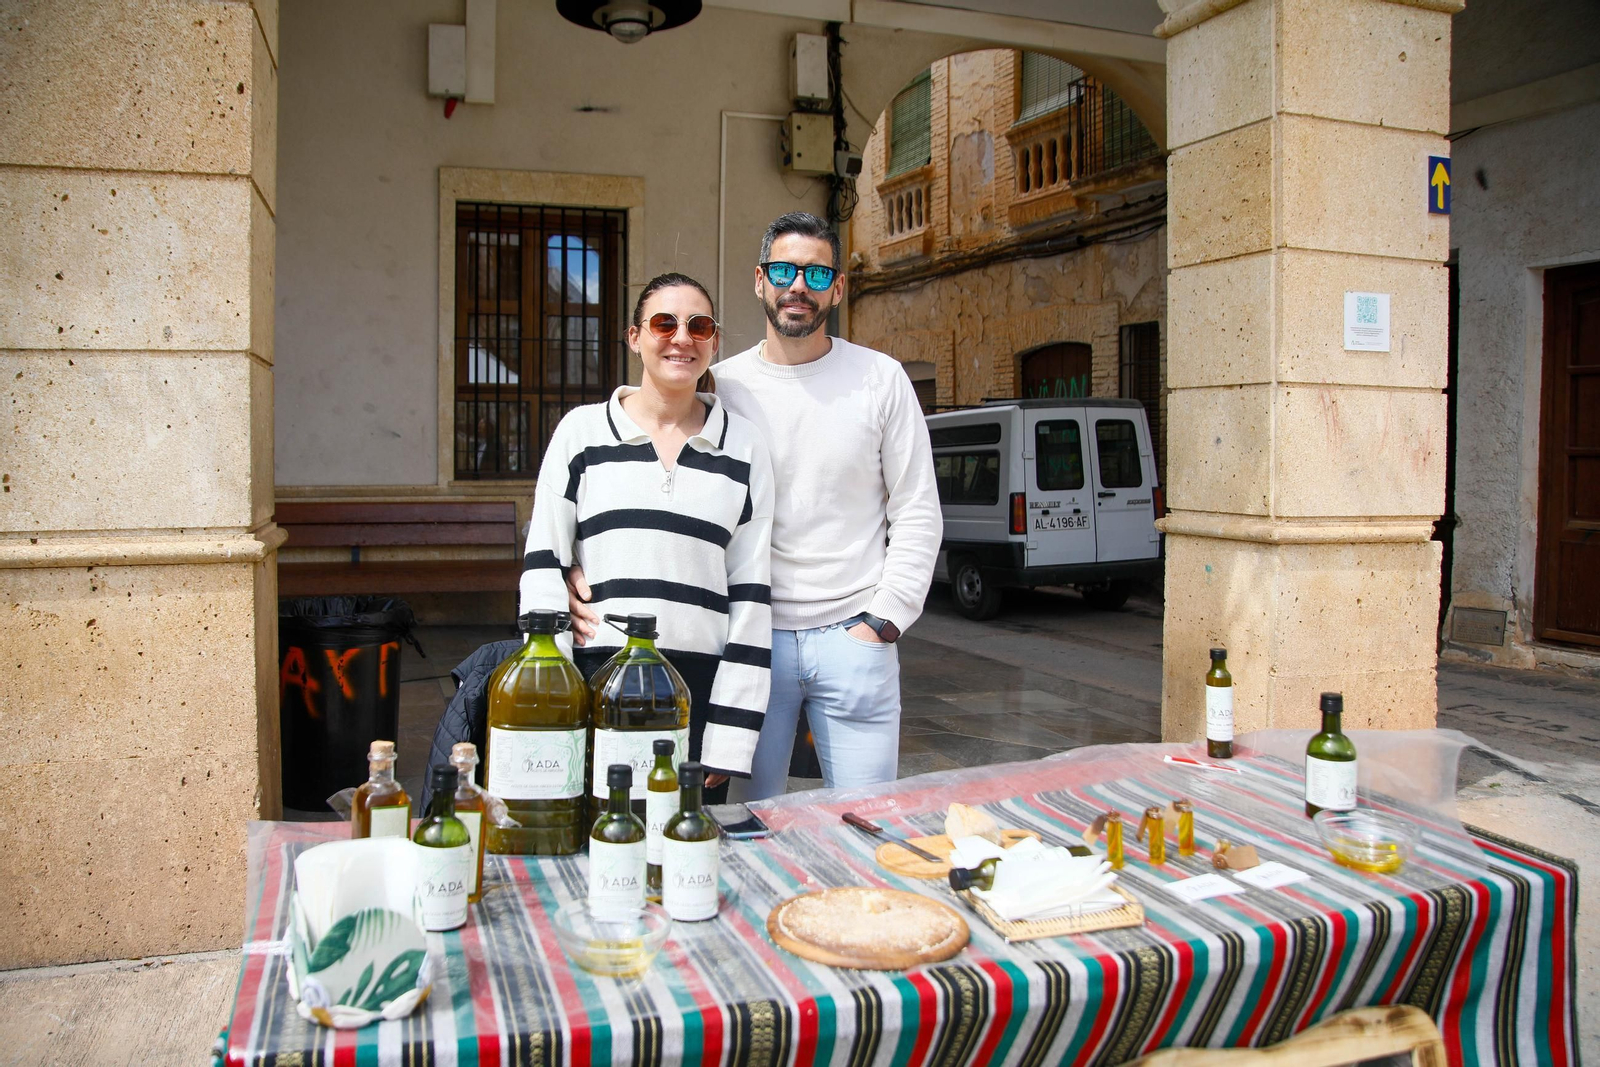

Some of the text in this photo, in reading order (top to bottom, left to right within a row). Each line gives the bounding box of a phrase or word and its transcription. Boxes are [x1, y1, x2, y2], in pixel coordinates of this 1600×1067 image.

[535, 759, 561, 769] ADA
[640, 759, 656, 769] AD
[611, 876, 638, 887] ADA
[687, 873, 713, 885] ADA
[437, 880, 465, 893] ADA
